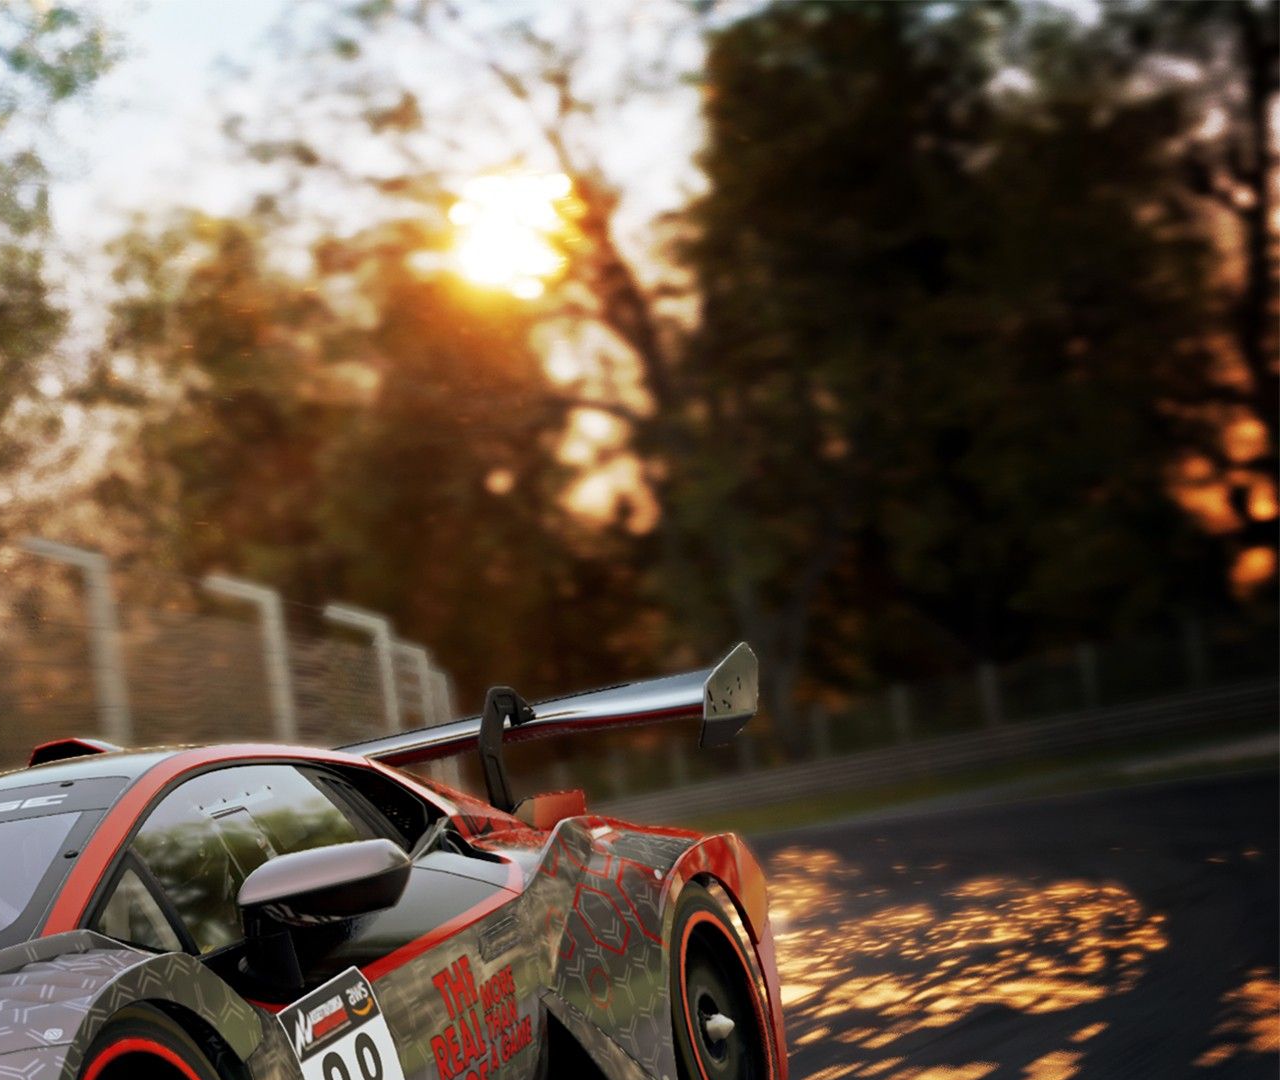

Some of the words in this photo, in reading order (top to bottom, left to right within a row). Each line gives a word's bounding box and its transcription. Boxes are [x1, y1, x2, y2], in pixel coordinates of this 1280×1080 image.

[345, 981, 369, 1006] aws
[432, 954, 478, 1021] THE
[480, 963, 515, 1012] MORE
[485, 999, 519, 1040] THAN
